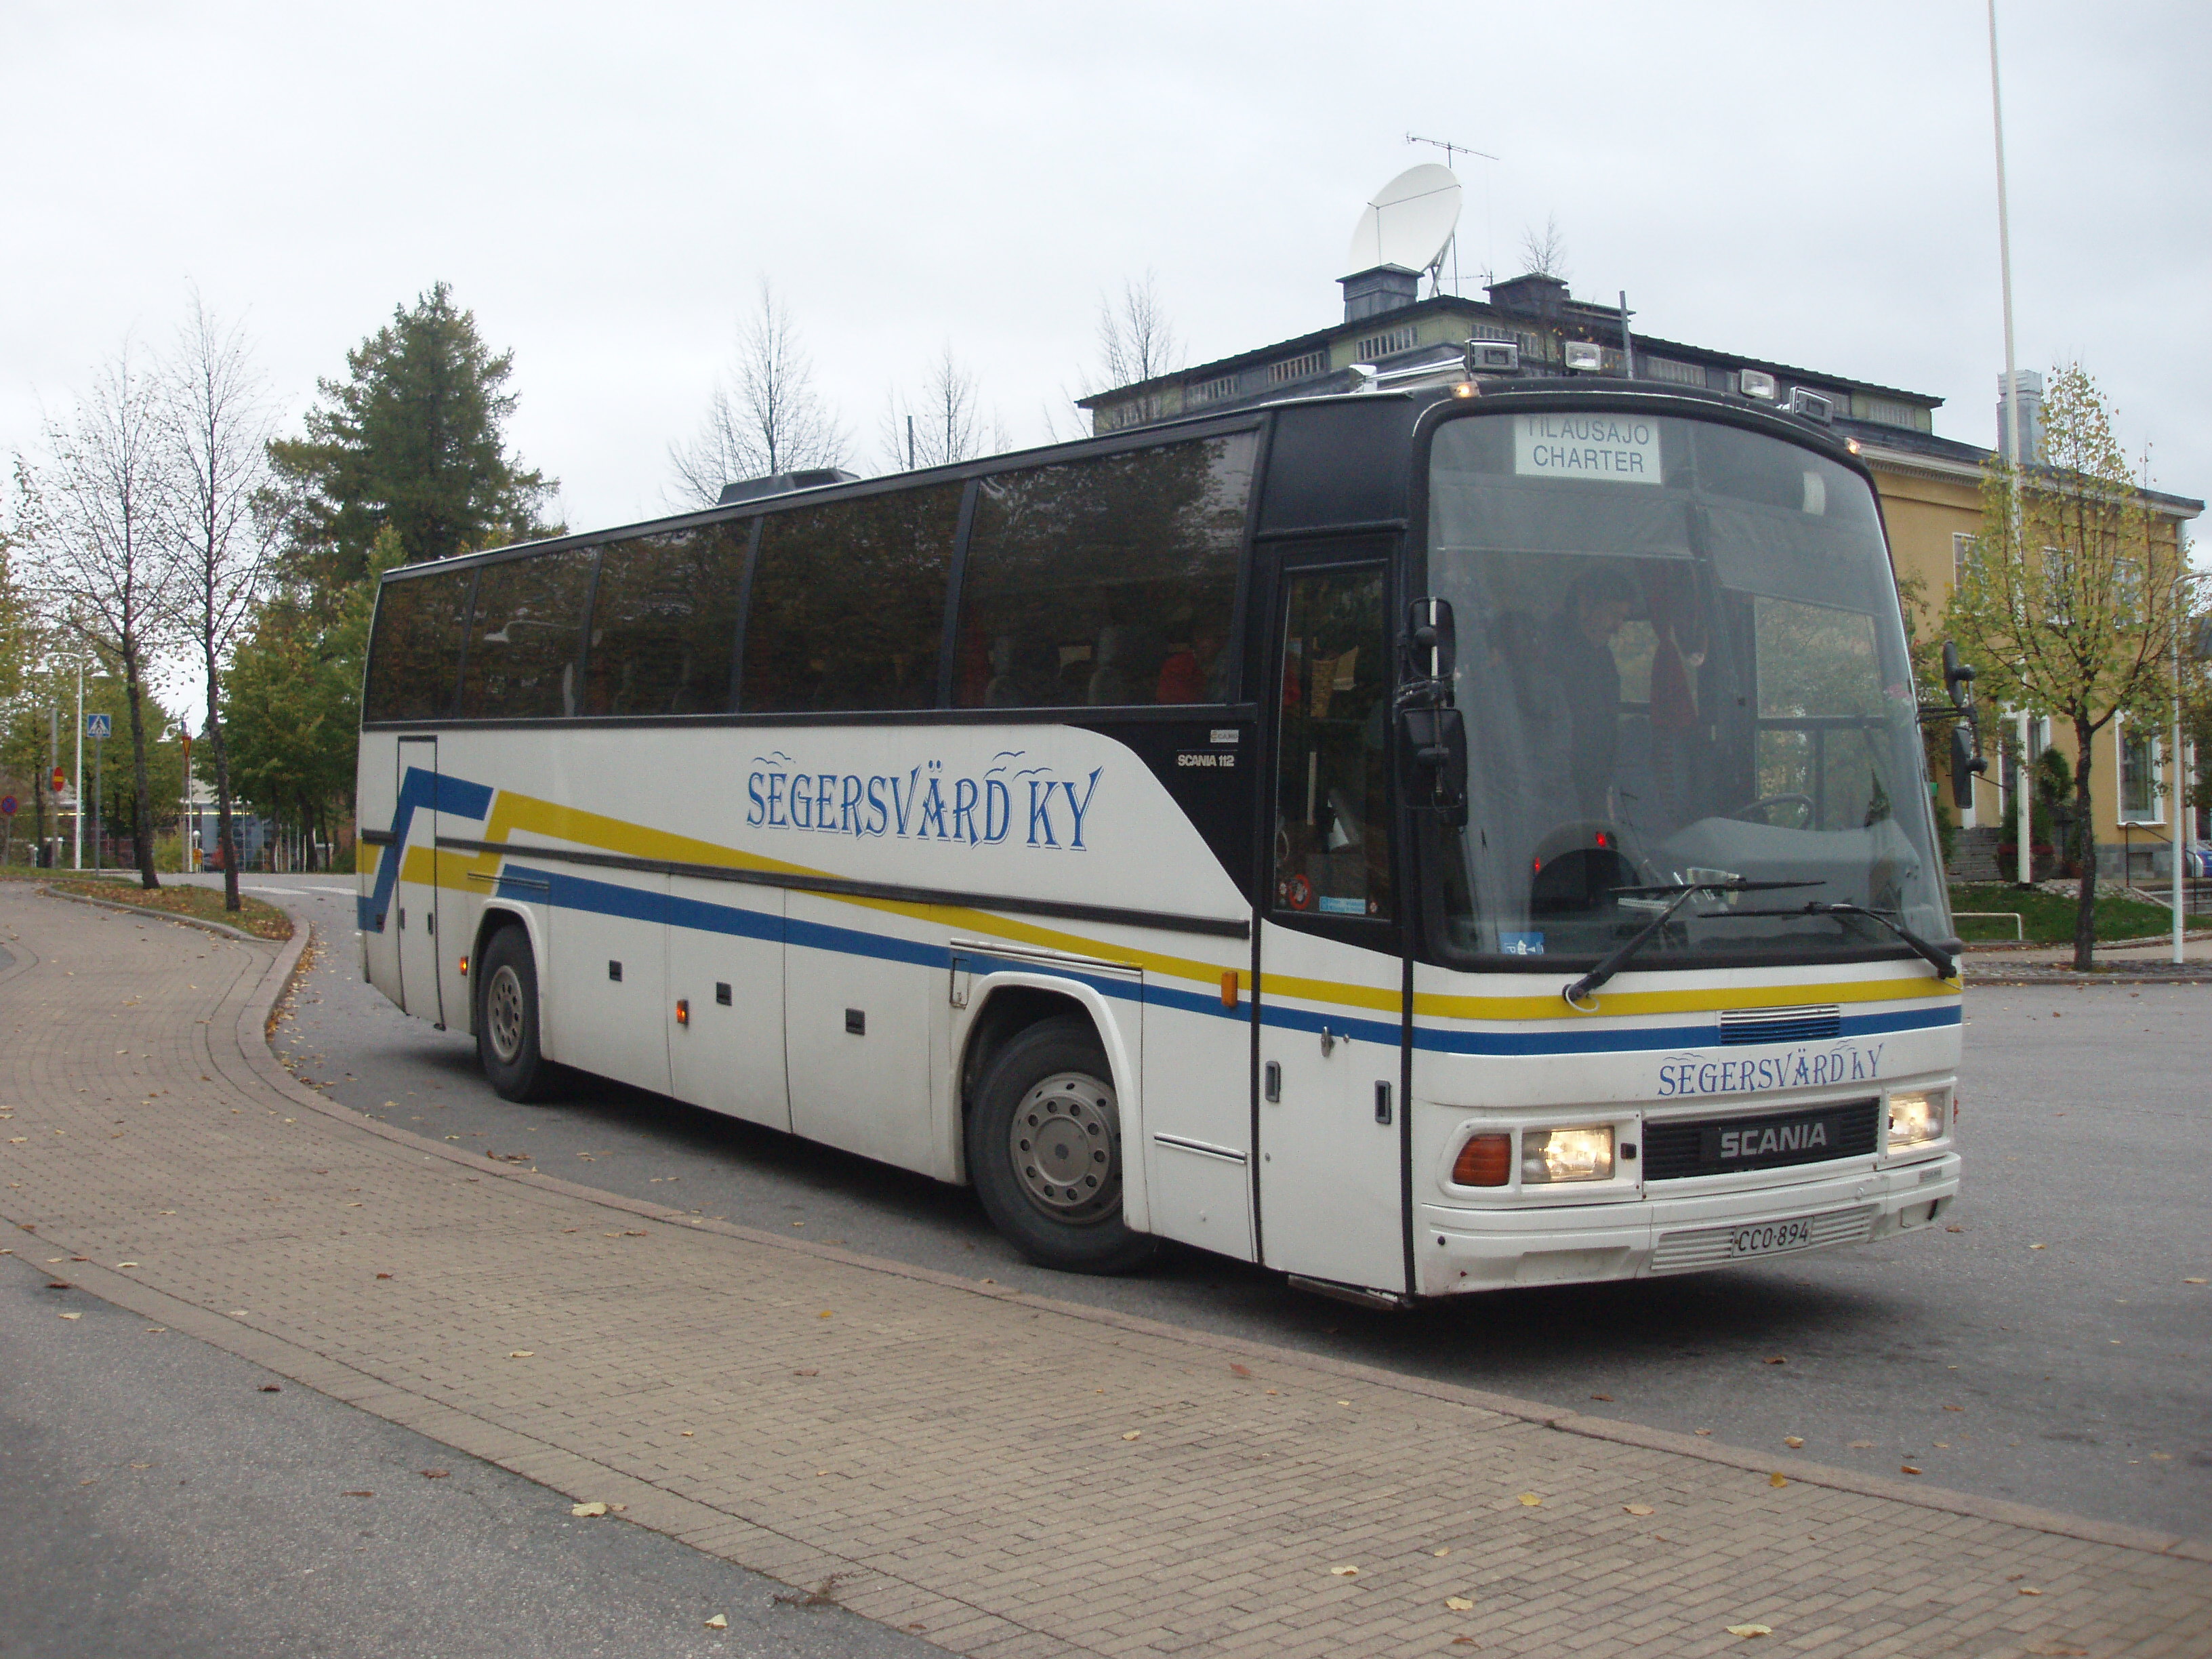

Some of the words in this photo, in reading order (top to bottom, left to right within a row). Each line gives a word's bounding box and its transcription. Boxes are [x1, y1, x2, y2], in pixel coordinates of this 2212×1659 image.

[1533, 445, 1644, 473] CHARTER
[1177, 754, 1216, 767] SCANIA
[1218, 755, 1235, 767] 112
[747, 760, 1012, 849] SEGERSVÄRD
[1026, 766, 1103, 851] KY
[1658, 1048, 1845, 1095] SEGERSVÄRD
[1851, 1042, 1885, 1079] KY
[1720, 1123, 1827, 1158] SCANIA
[1737, 1221, 1810, 1252] CCO-894
